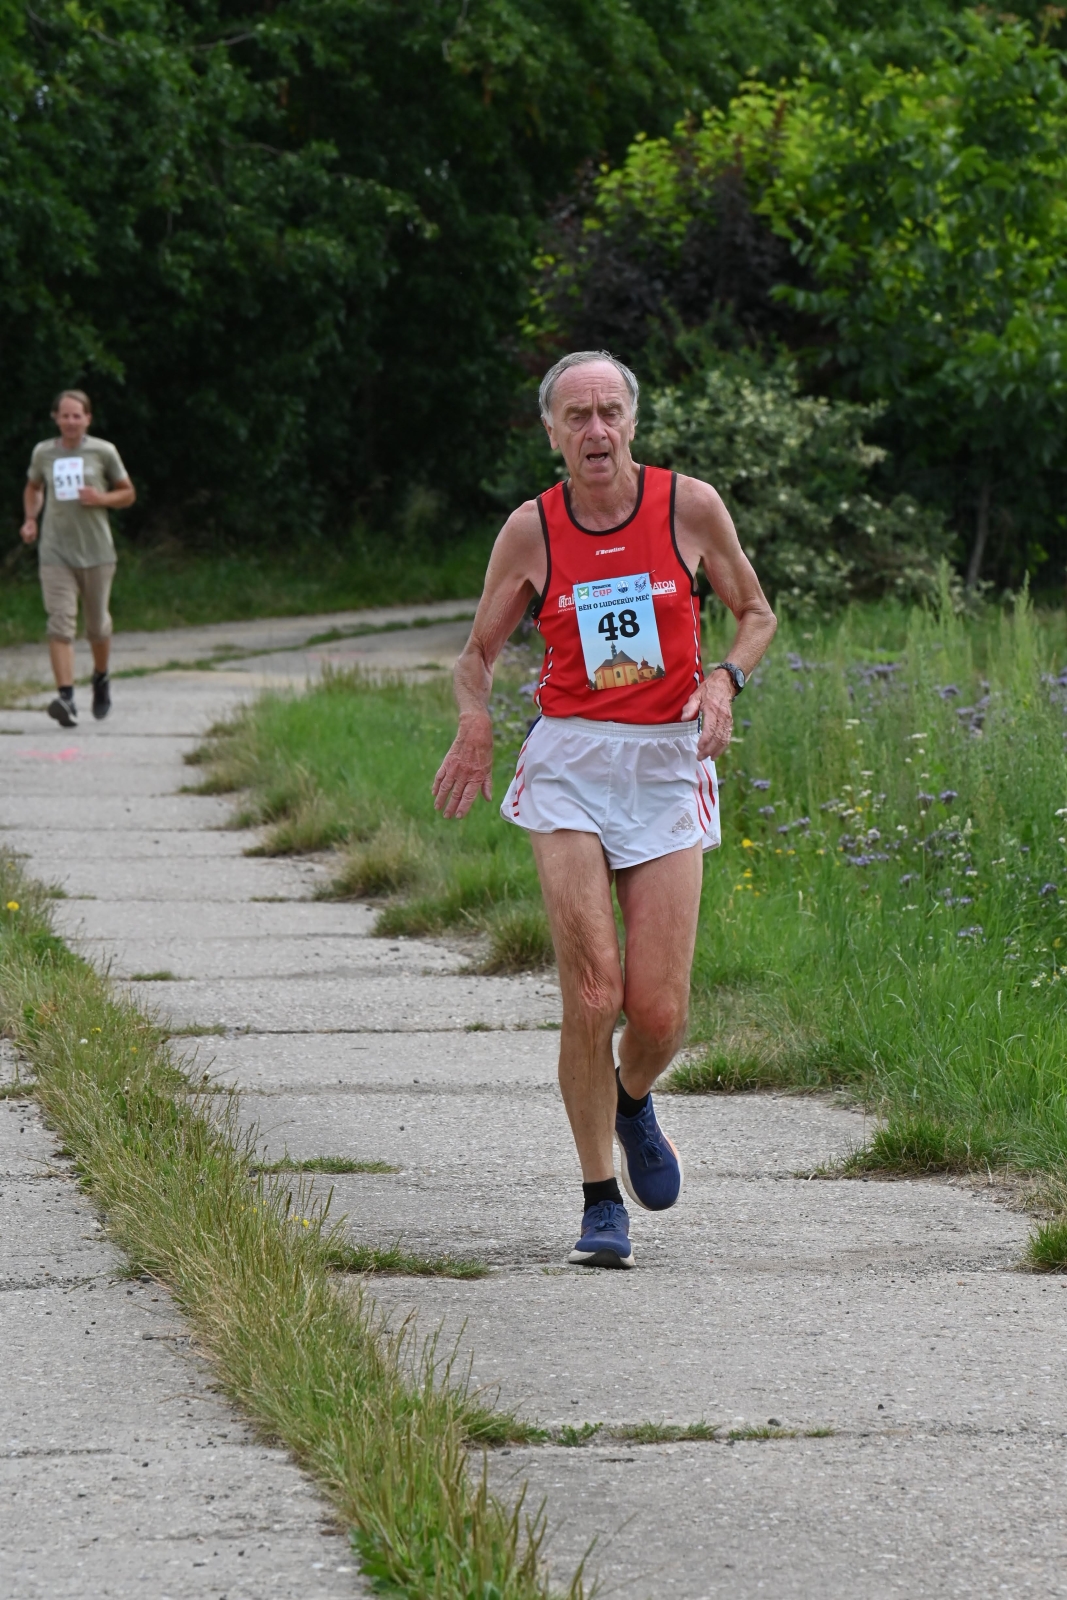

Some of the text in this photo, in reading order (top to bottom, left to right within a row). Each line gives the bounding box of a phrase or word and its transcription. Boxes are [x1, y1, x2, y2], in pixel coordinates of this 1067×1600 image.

[55, 474, 82, 487] 511
[635, 594, 650, 602] MEČ
[598, 609, 640, 641] 48
